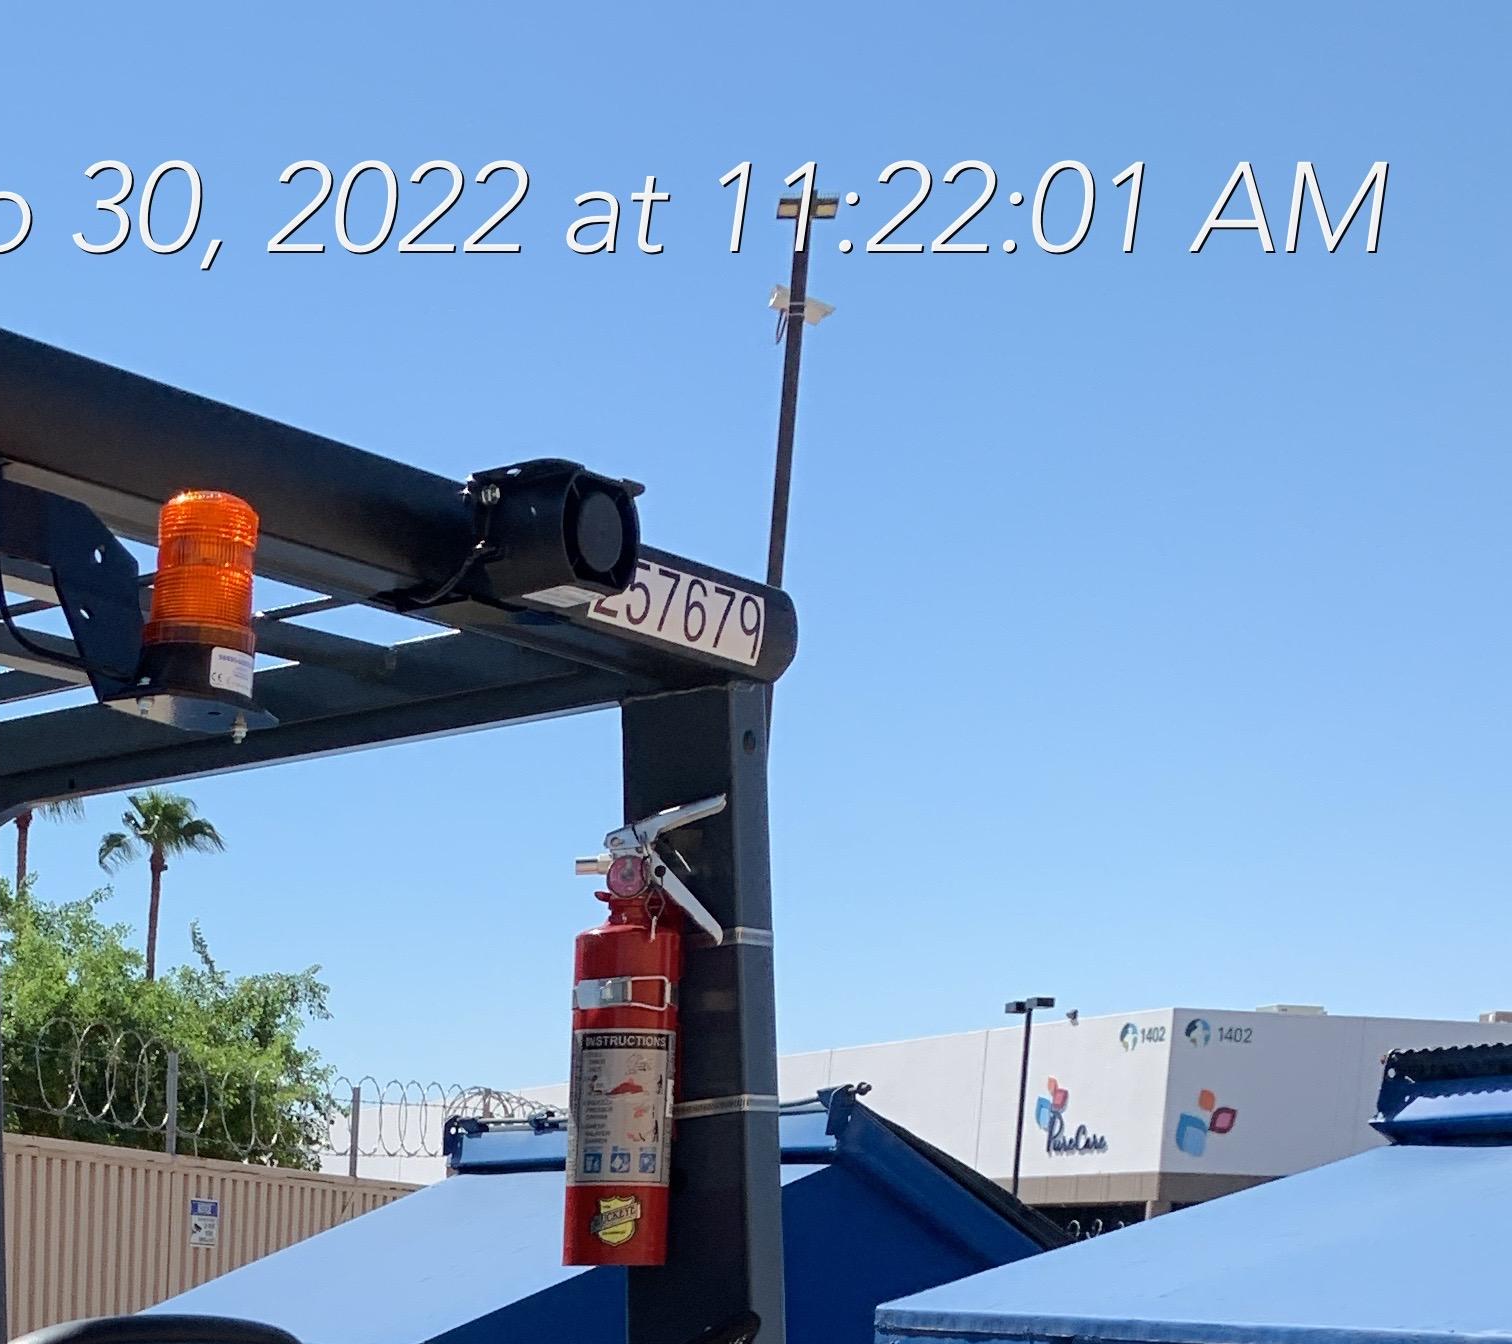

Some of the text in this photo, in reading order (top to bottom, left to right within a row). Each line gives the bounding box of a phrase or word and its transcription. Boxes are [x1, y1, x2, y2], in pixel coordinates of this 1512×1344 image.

[584, 1034, 667, 1048] INSTRUCTIONS
[1140, 1026, 1167, 1043] 1402
[1218, 1026, 1253, 1043] 1402
[1047, 1111, 1107, 1153] PureCare
